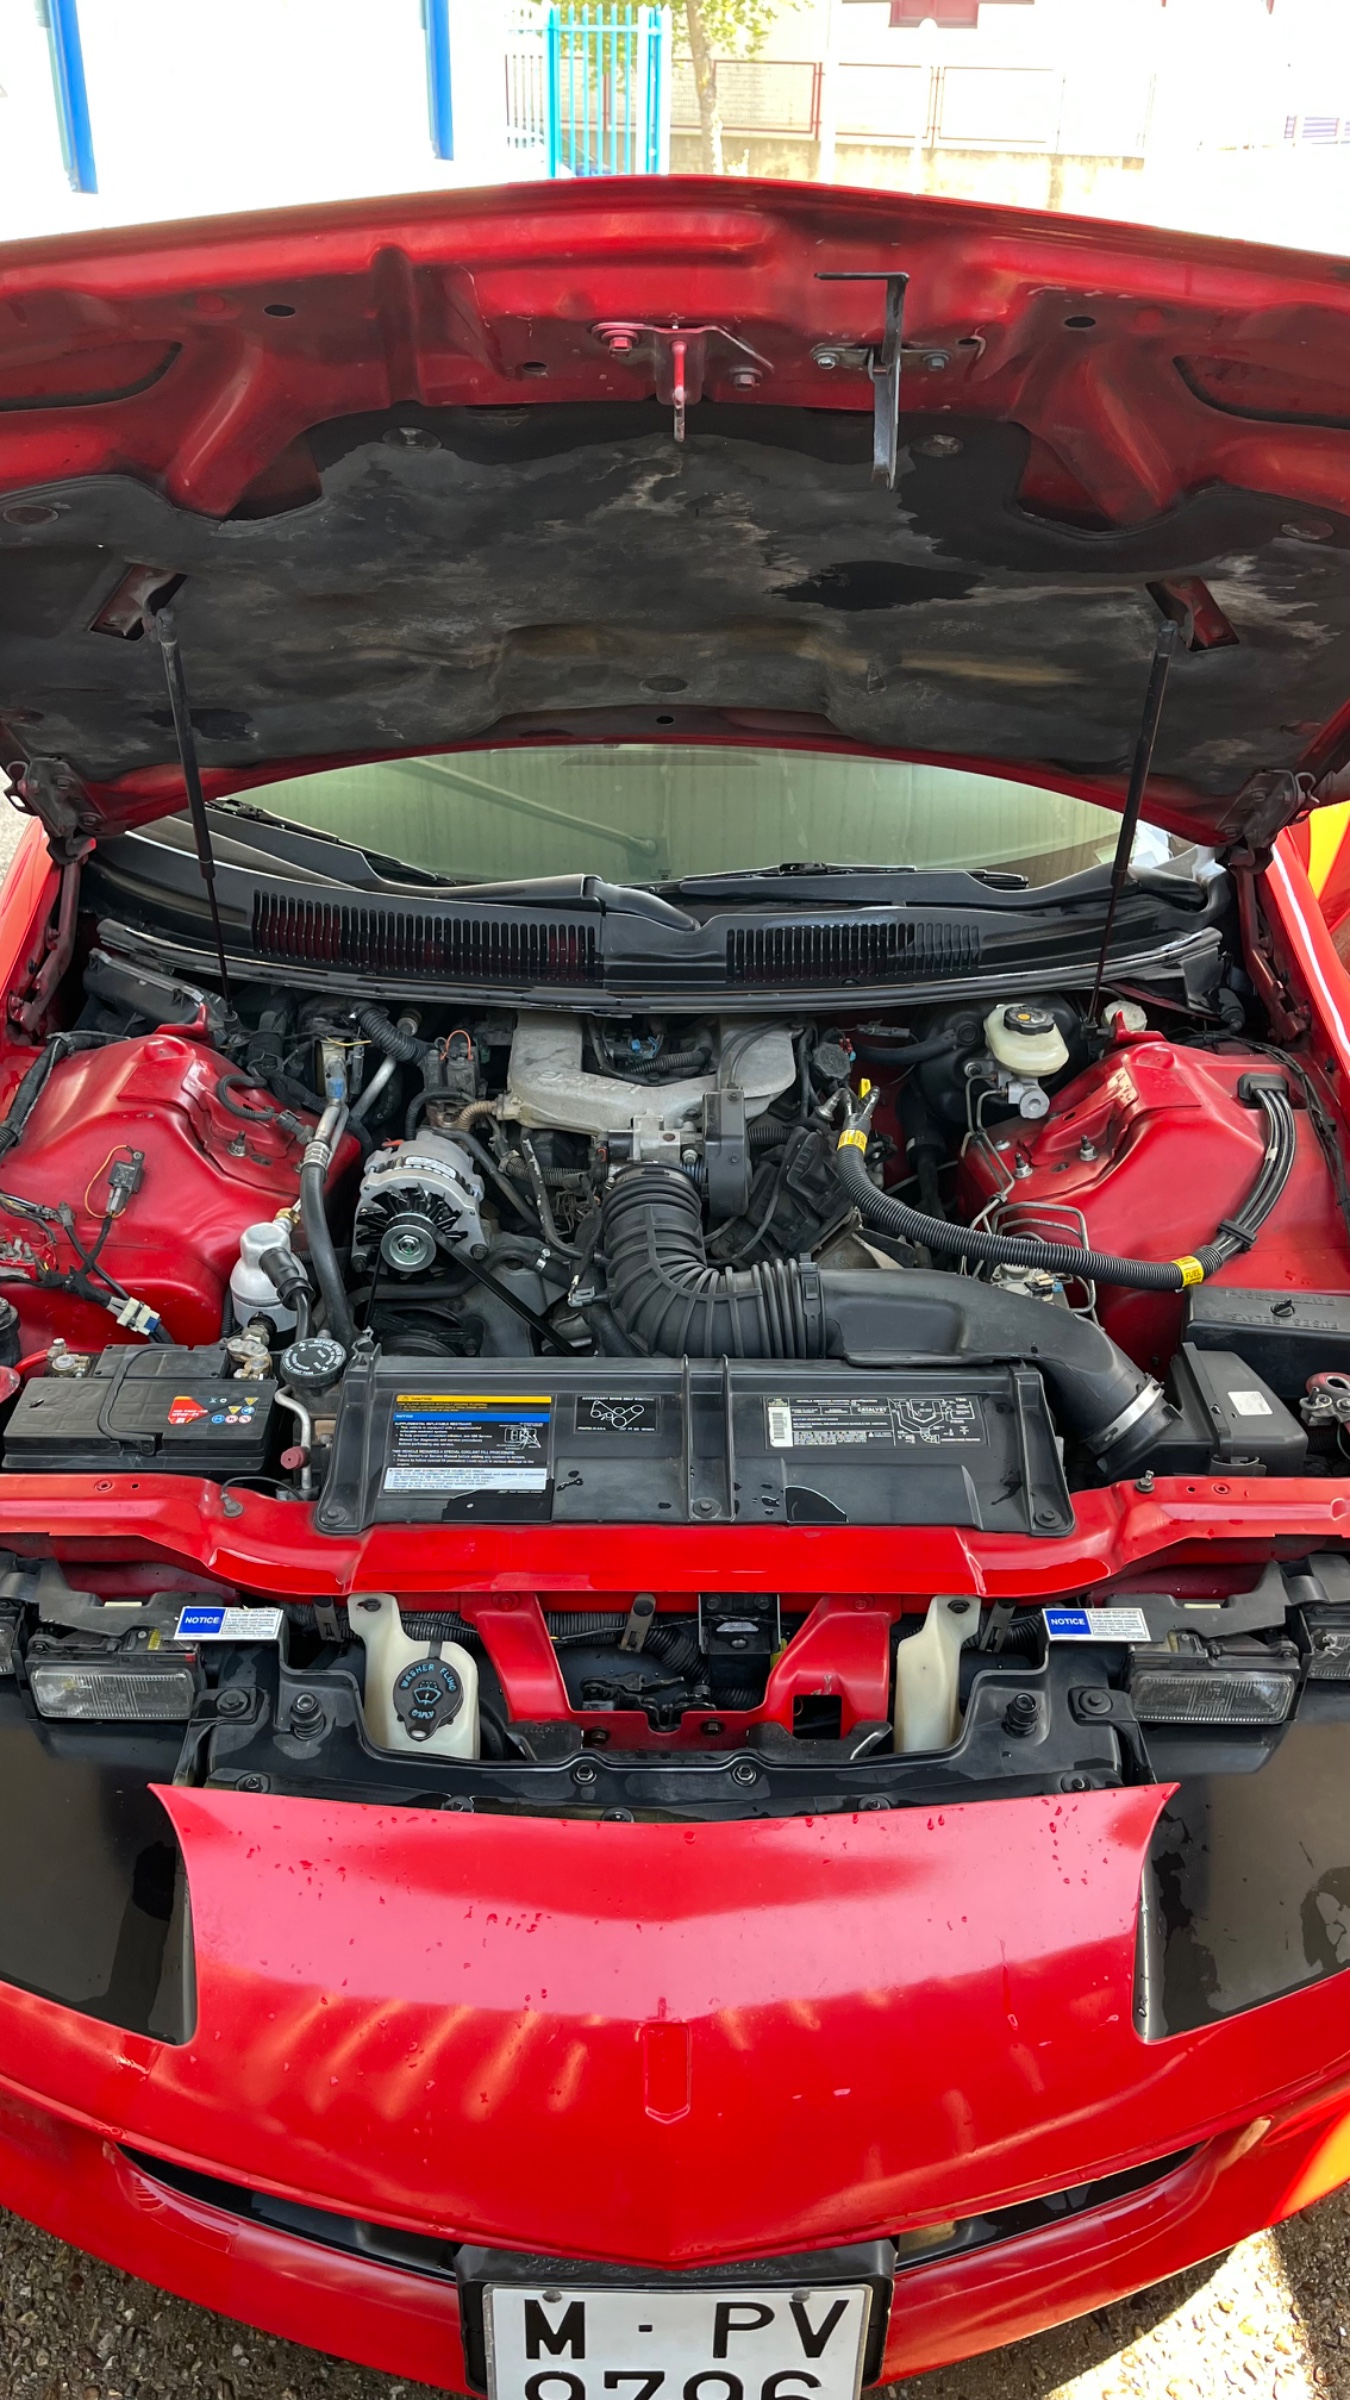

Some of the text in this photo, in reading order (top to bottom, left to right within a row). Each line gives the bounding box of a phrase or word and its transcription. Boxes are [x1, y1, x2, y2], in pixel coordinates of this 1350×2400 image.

[1185, 1270, 1202, 1280] FUEL
[184, 1616, 221, 1624] NOTICE
[1050, 1618, 1085, 1626] NOTICE
[400, 1663, 435, 1688] WASHER
[524, 2299, 586, 2360] M
[713, 2299, 850, 2360] PV
